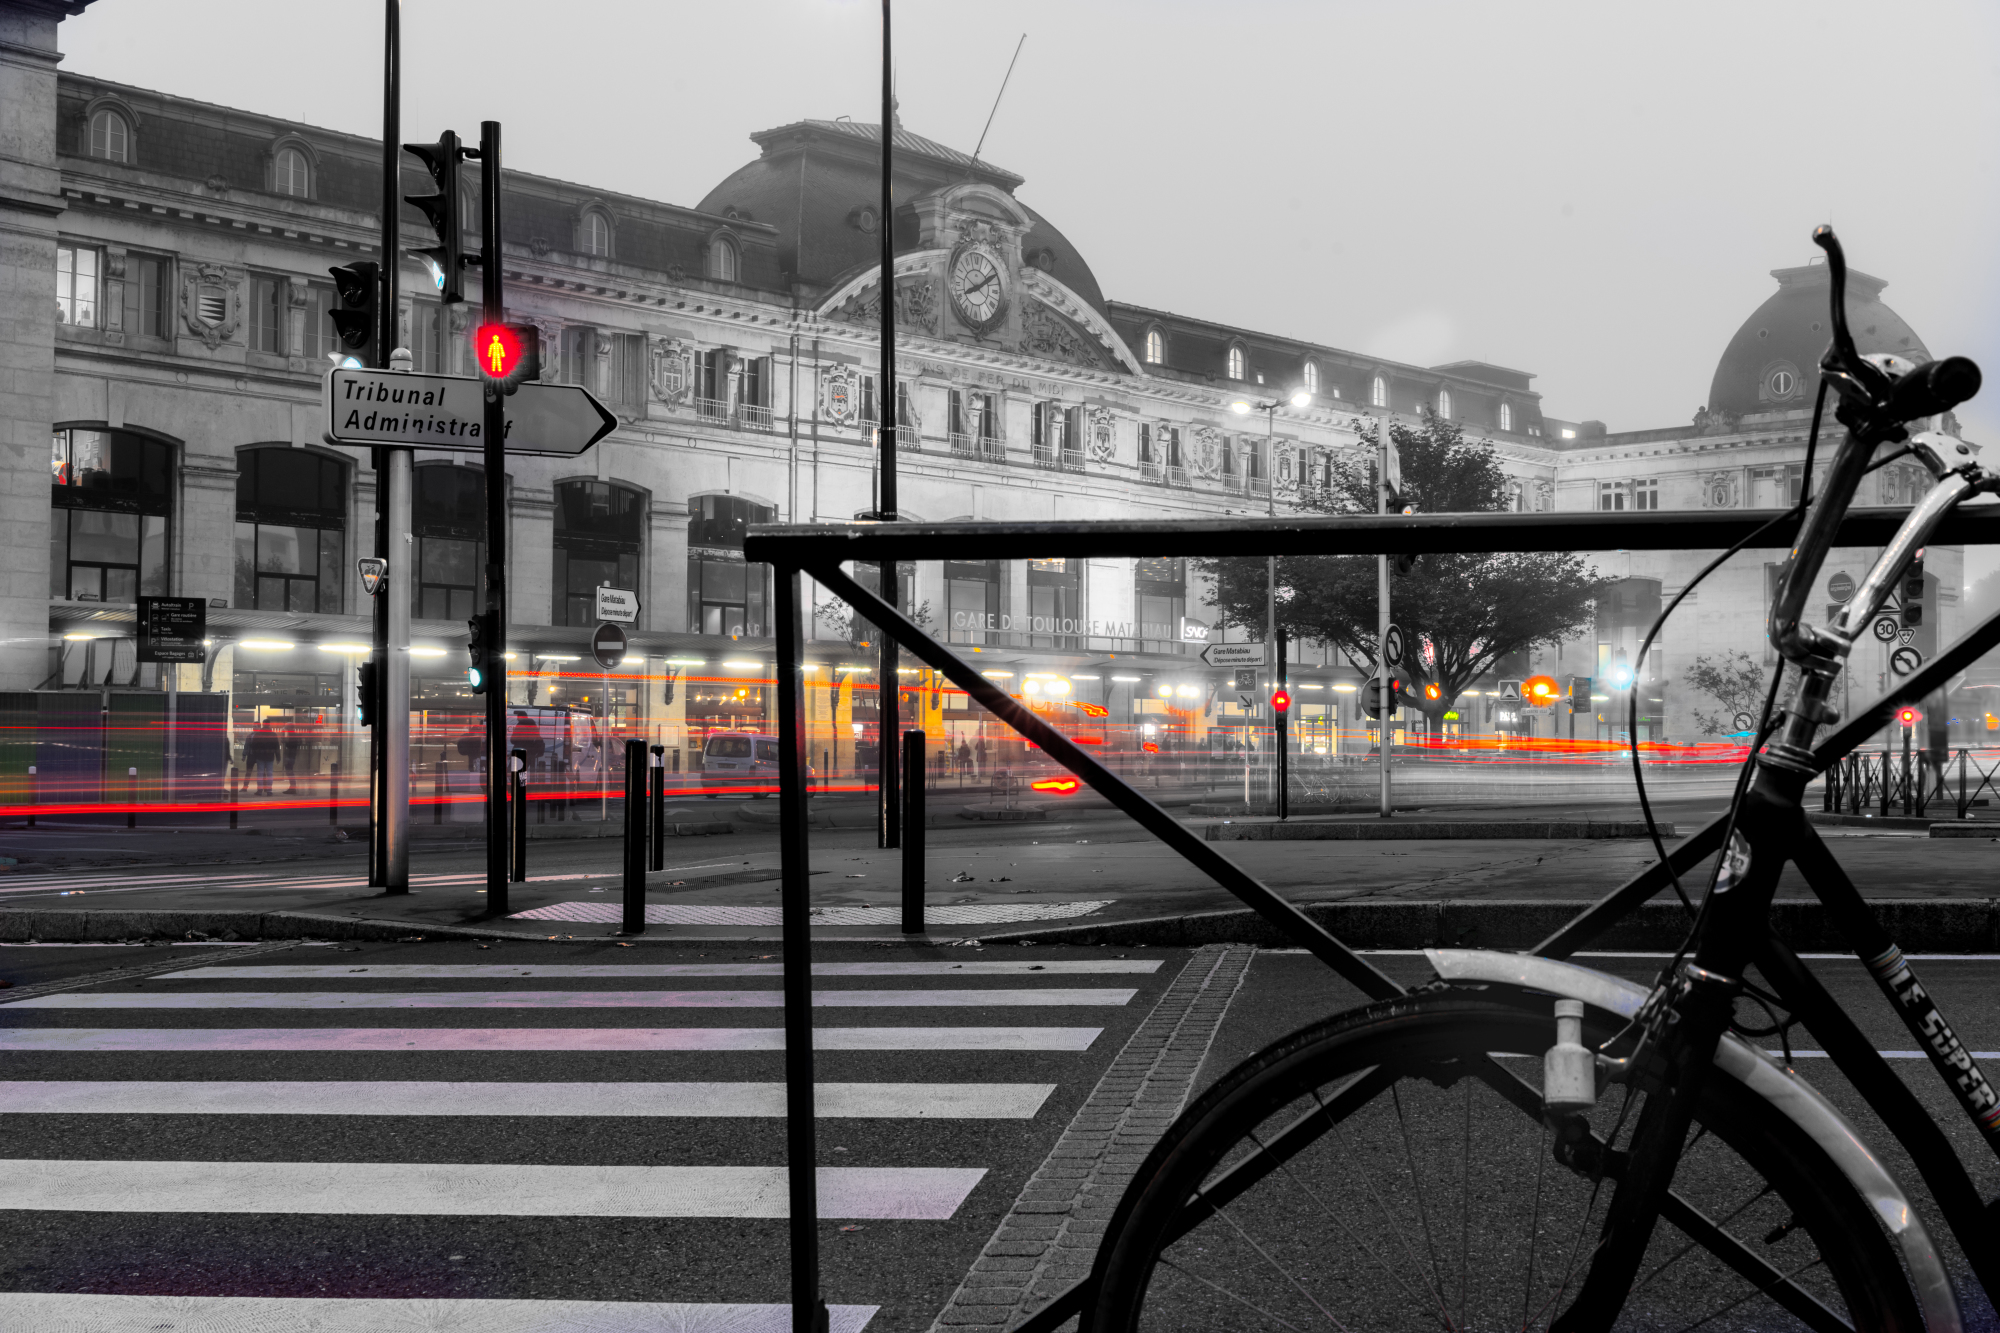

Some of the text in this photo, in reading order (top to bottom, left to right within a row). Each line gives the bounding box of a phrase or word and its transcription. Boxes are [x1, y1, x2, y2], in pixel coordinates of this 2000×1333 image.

[895, 359, 944, 375] HEMINS
[952, 367, 969, 380] DE
[1013, 377, 1030, 390] DU
[1038, 381, 1065, 396] MIDI
[344, 379, 446, 406] Tribunal
[344, 409, 513, 439] Administraf
[601, 593, 626, 604] Gare Matabiau
[954, 611, 1172, 639] GARE DE TOULOUSE MATABIAU
[1878, 623, 1894, 635] 30
[1213, 647, 1251, 655] Gare Matabiau
[1888, 967, 1997, 1110] LE SUPER
